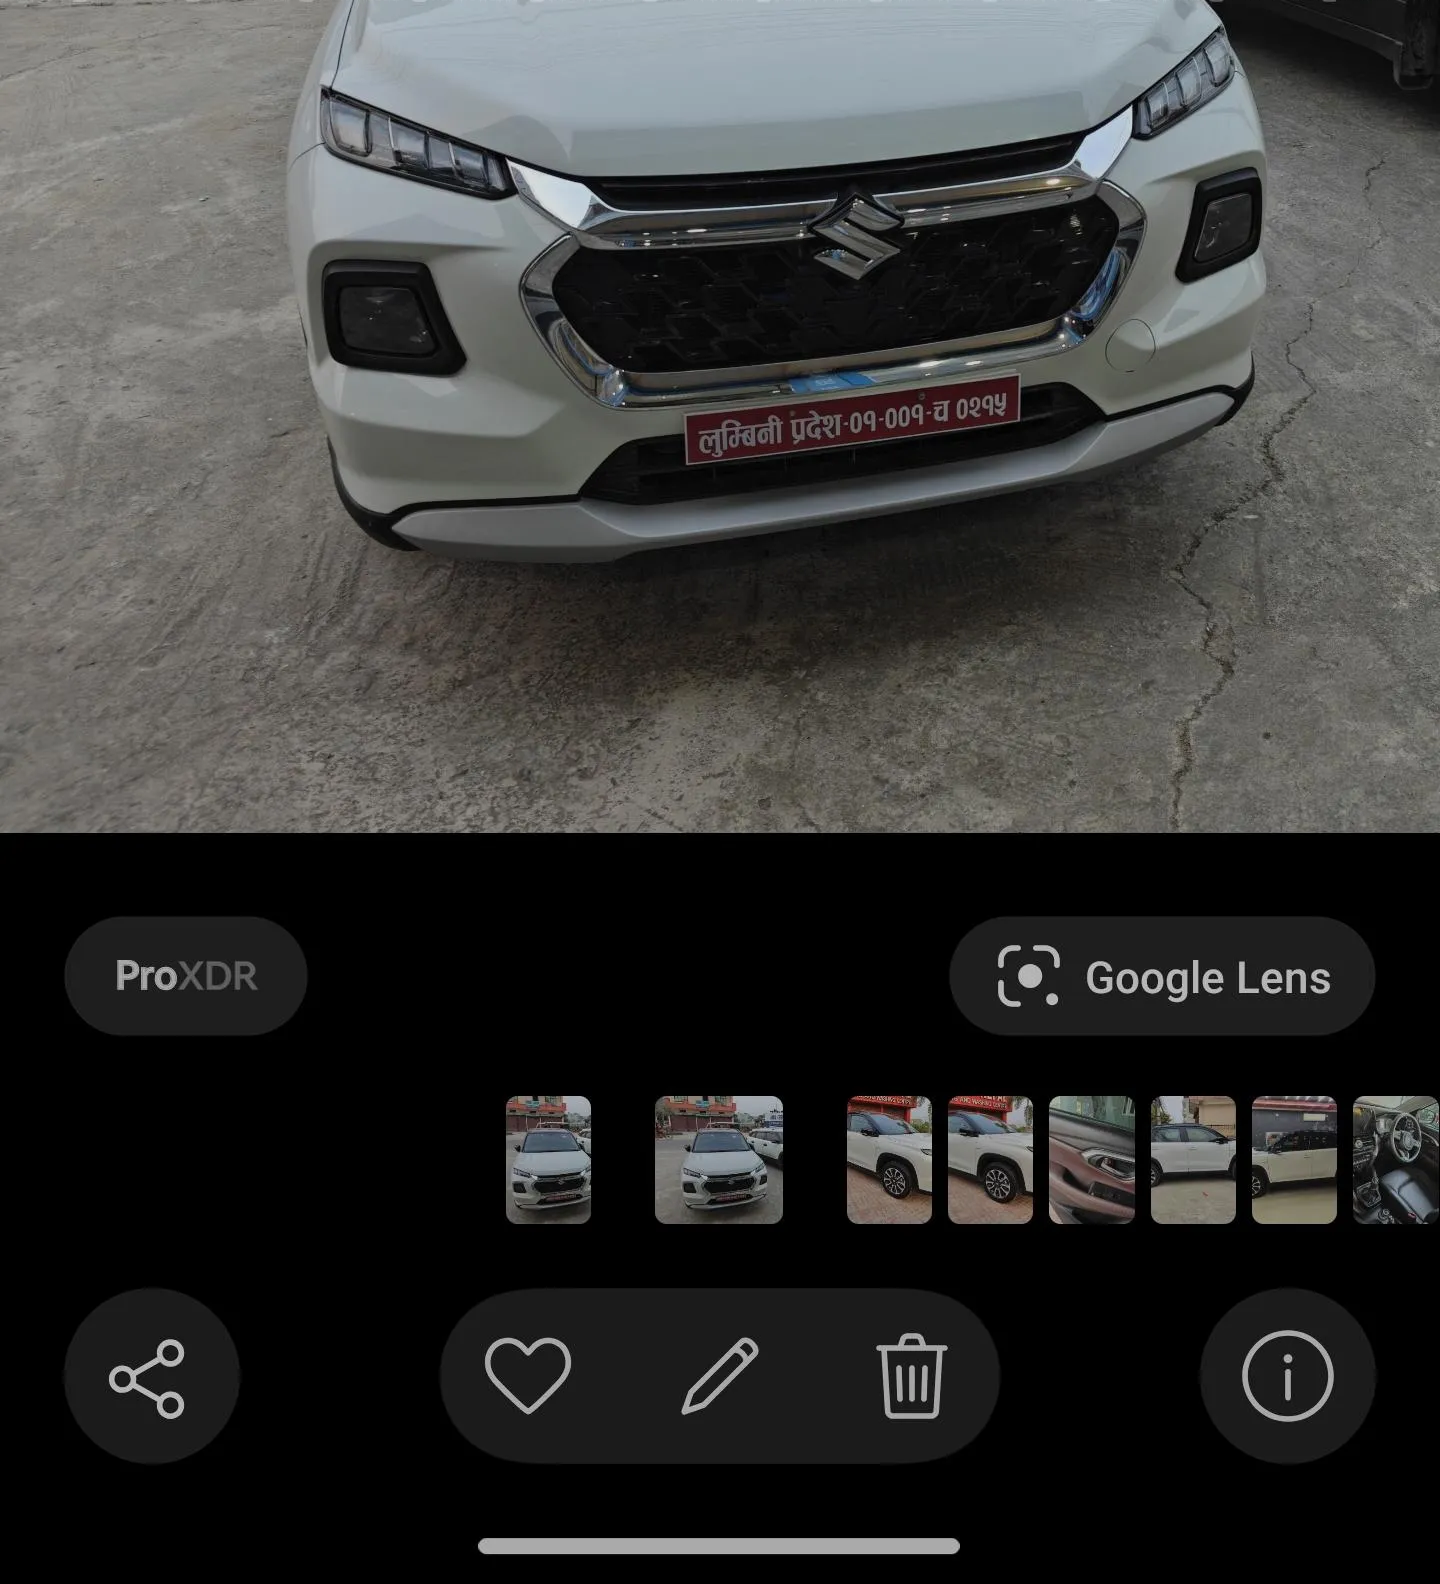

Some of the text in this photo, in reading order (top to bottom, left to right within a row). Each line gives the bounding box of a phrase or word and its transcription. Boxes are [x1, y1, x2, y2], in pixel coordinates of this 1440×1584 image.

[699, 415, 782, 457] लुम्बिनी
[957, 392, 1007, 420] ०२१५
[117, 960, 258, 991] ProXDR
[1087, 960, 1330, 1002] Google Lens
